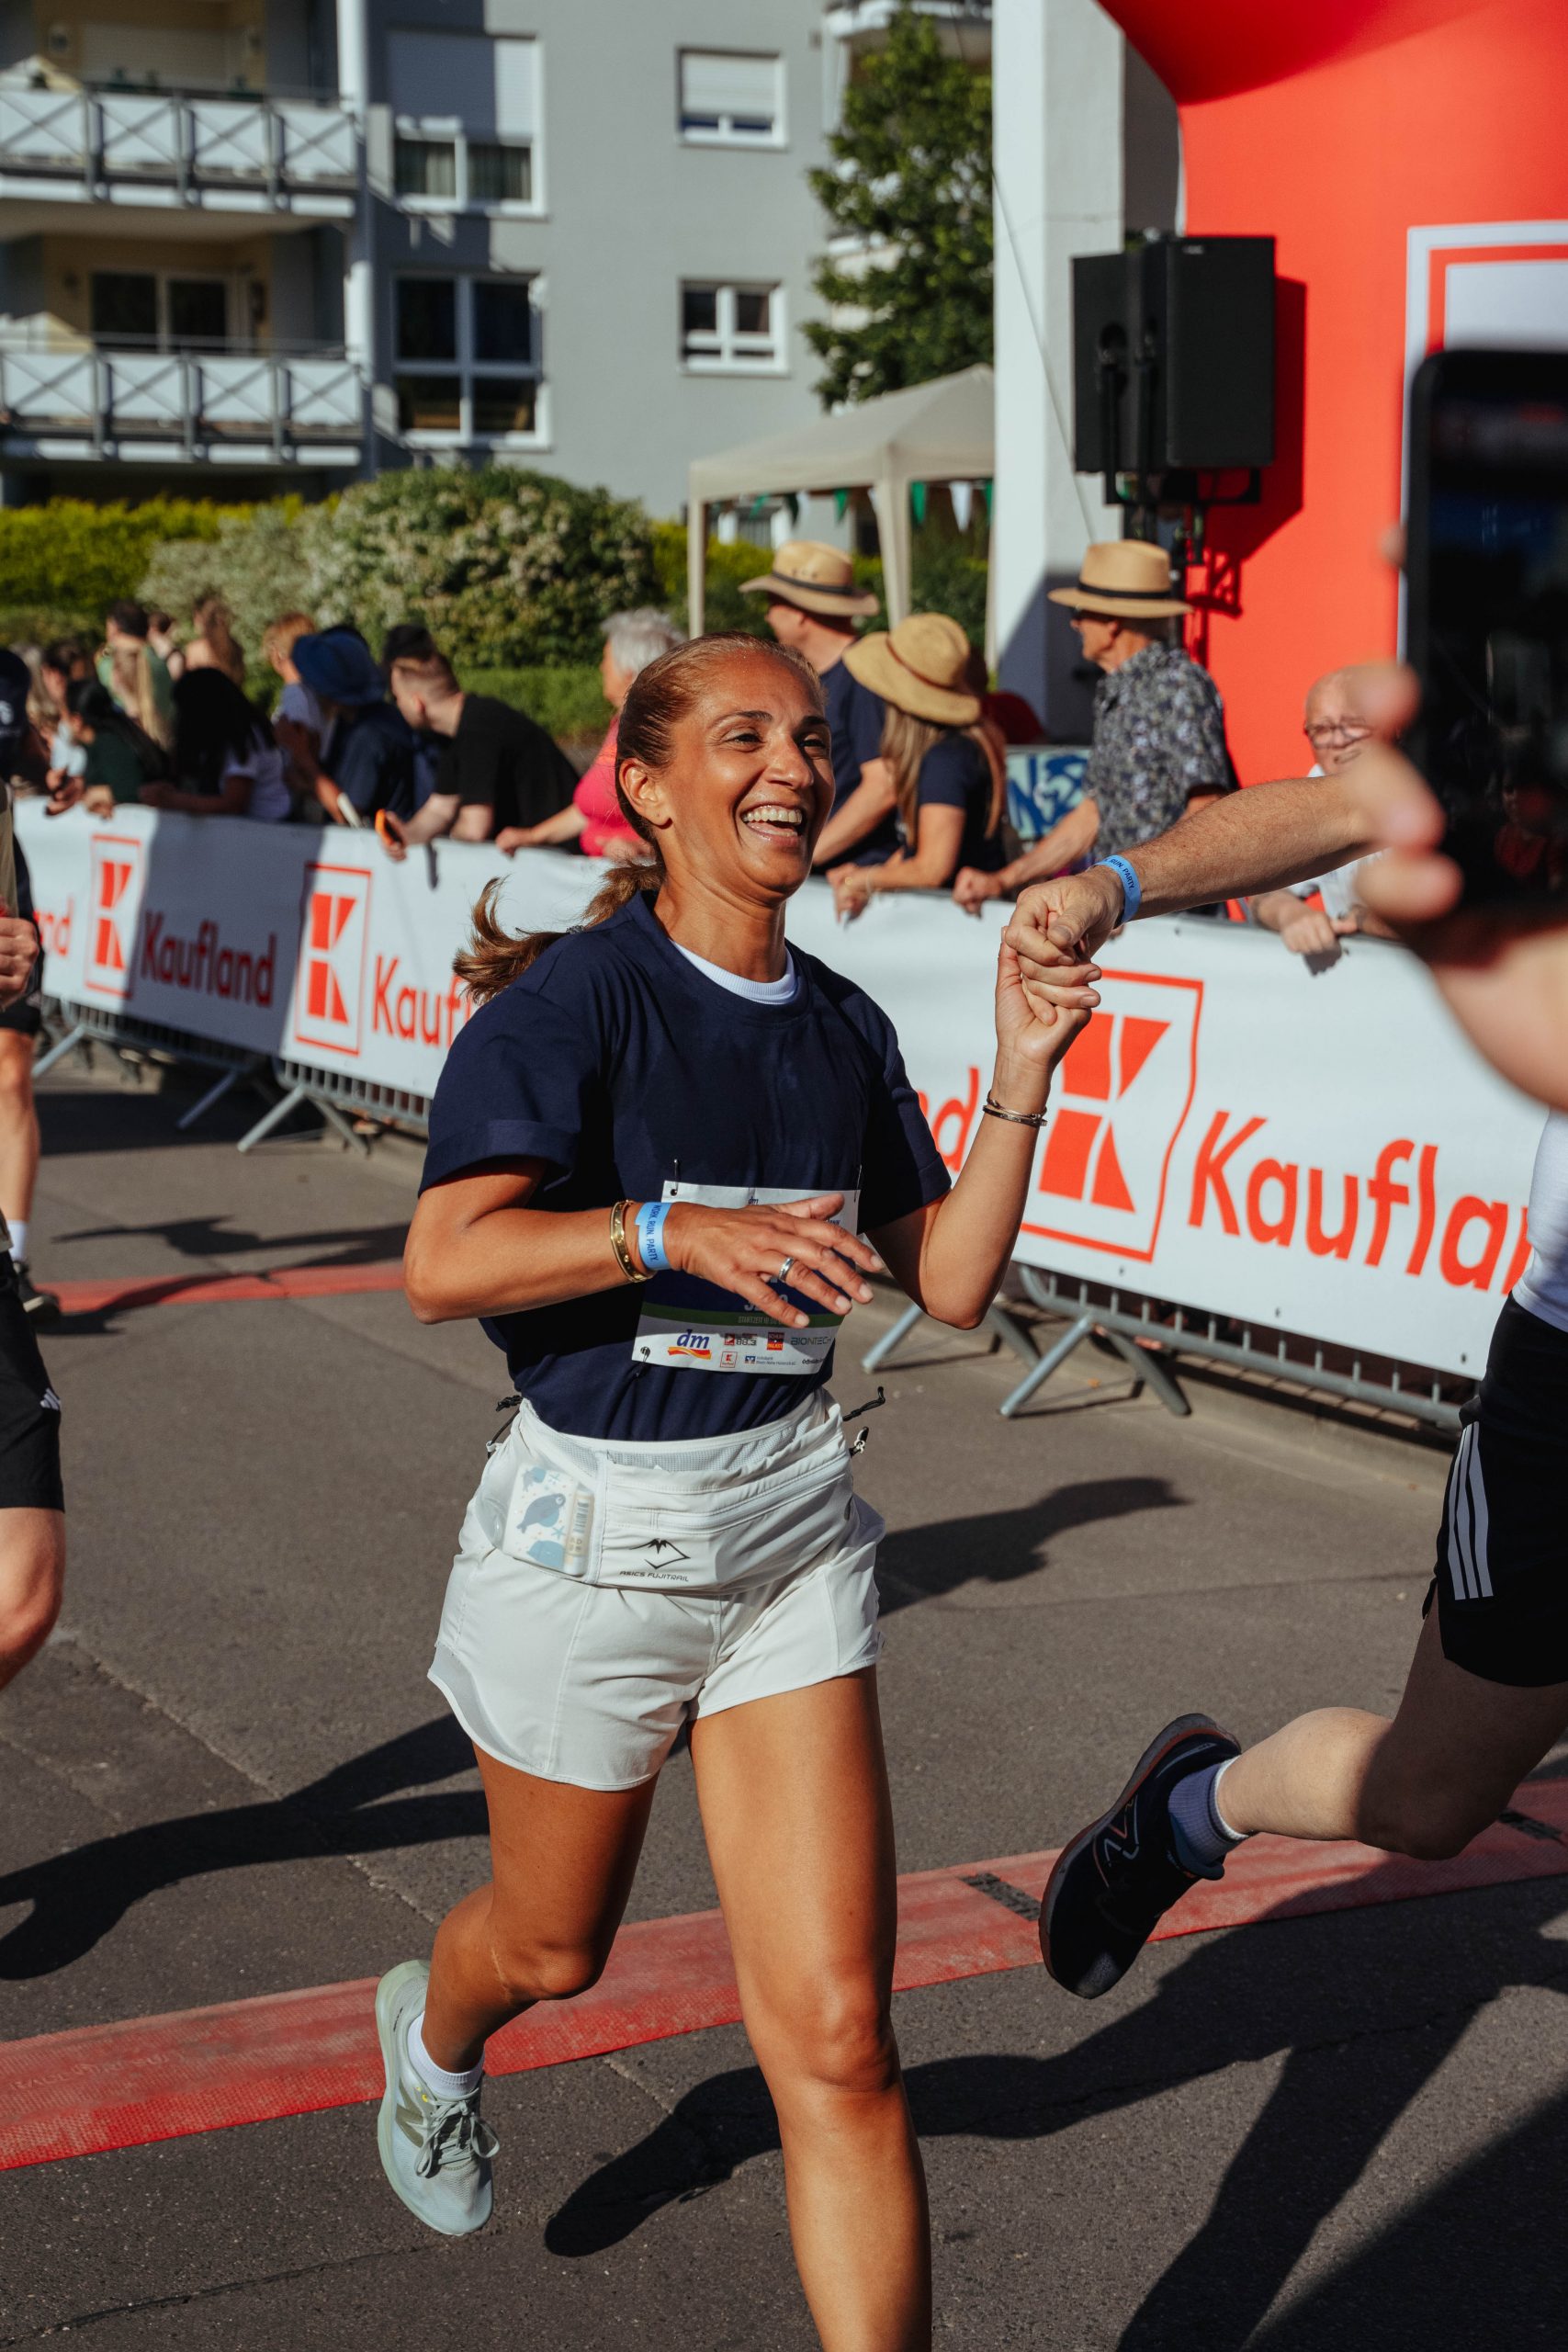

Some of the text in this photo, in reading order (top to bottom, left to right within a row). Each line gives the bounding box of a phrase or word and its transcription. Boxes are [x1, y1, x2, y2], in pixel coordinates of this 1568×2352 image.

[141, 910, 277, 1008] Kaufland
[372, 954, 472, 1048] Kauf
[1188, 1109, 1533, 1296] Kaufla
[677, 1329, 709, 1349] dm
[736, 1338, 757, 1346] 88.3
[647, 1572, 689, 1582] FUJITRAIL
